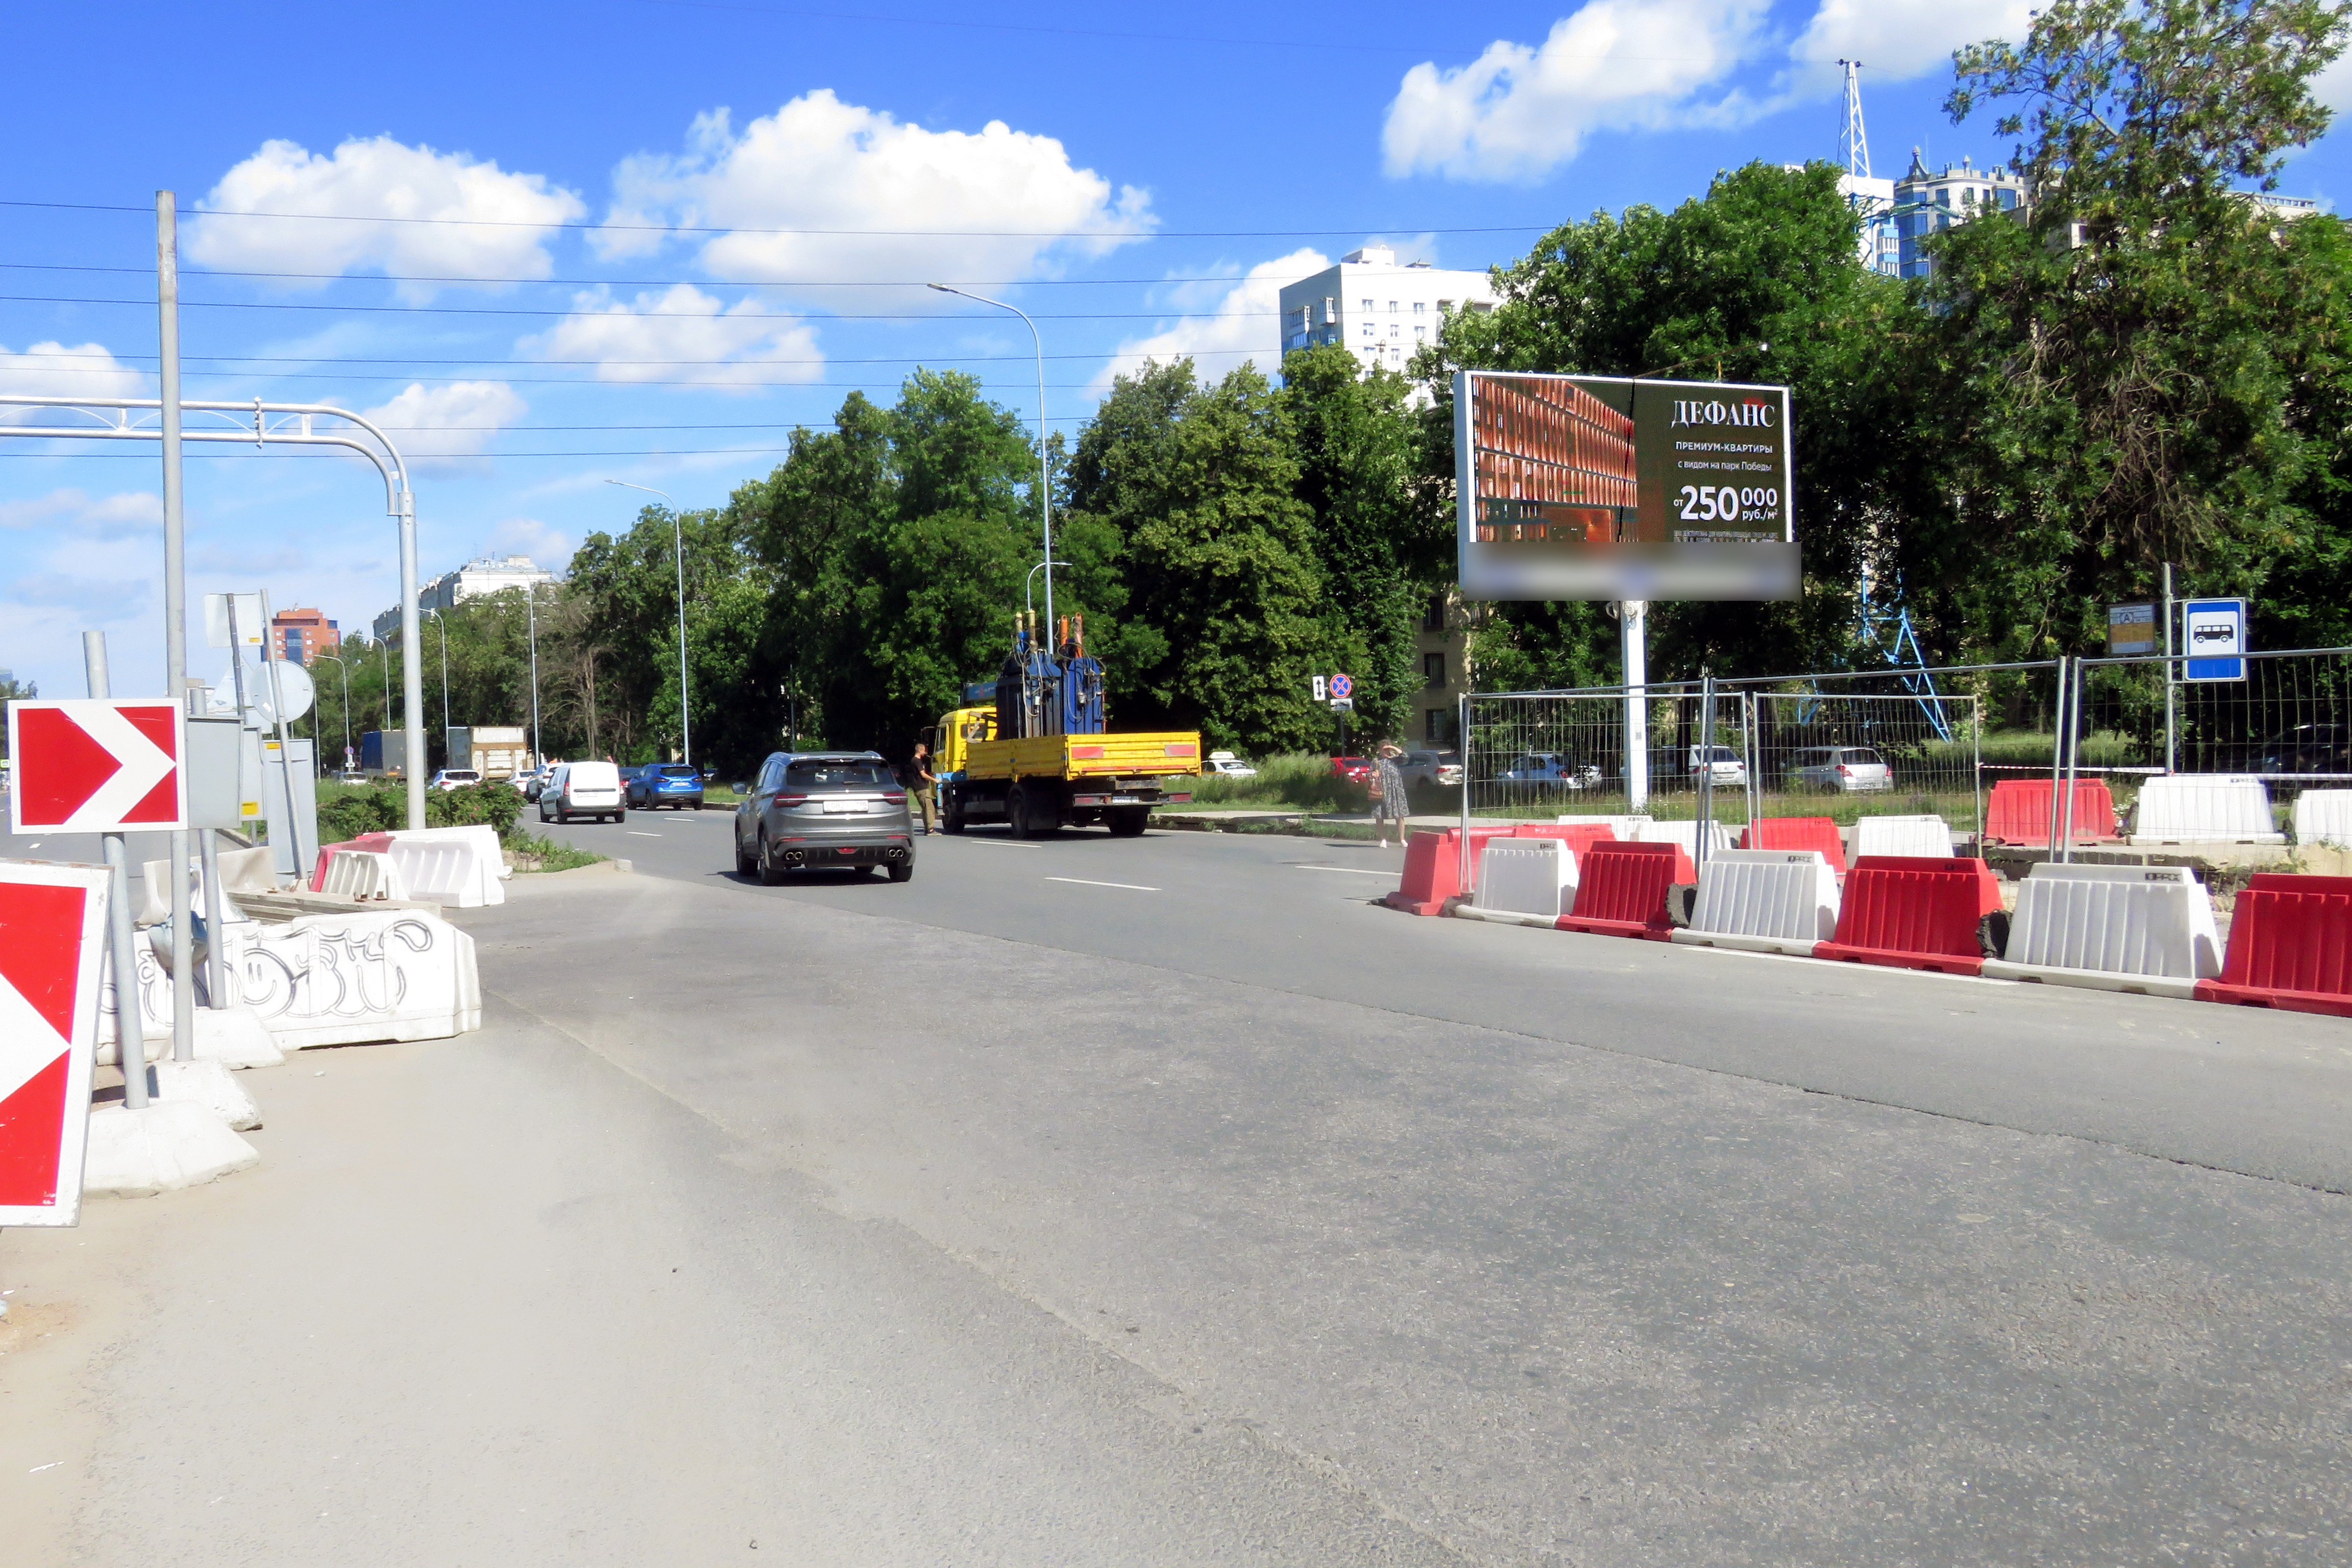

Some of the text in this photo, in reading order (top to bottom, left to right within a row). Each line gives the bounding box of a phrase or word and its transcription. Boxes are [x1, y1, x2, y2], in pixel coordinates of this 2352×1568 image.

[1671, 400, 1775, 428] ДЕФАНС
[1676, 442, 1773, 453] ПРЕМИУМ-КВАРТИРЫ
[1684, 461, 1709, 470] видом
[1721, 462, 1741, 472] парк
[1741, 461, 1772, 472] Победы
[1673, 485, 1778, 521] от 250 000
